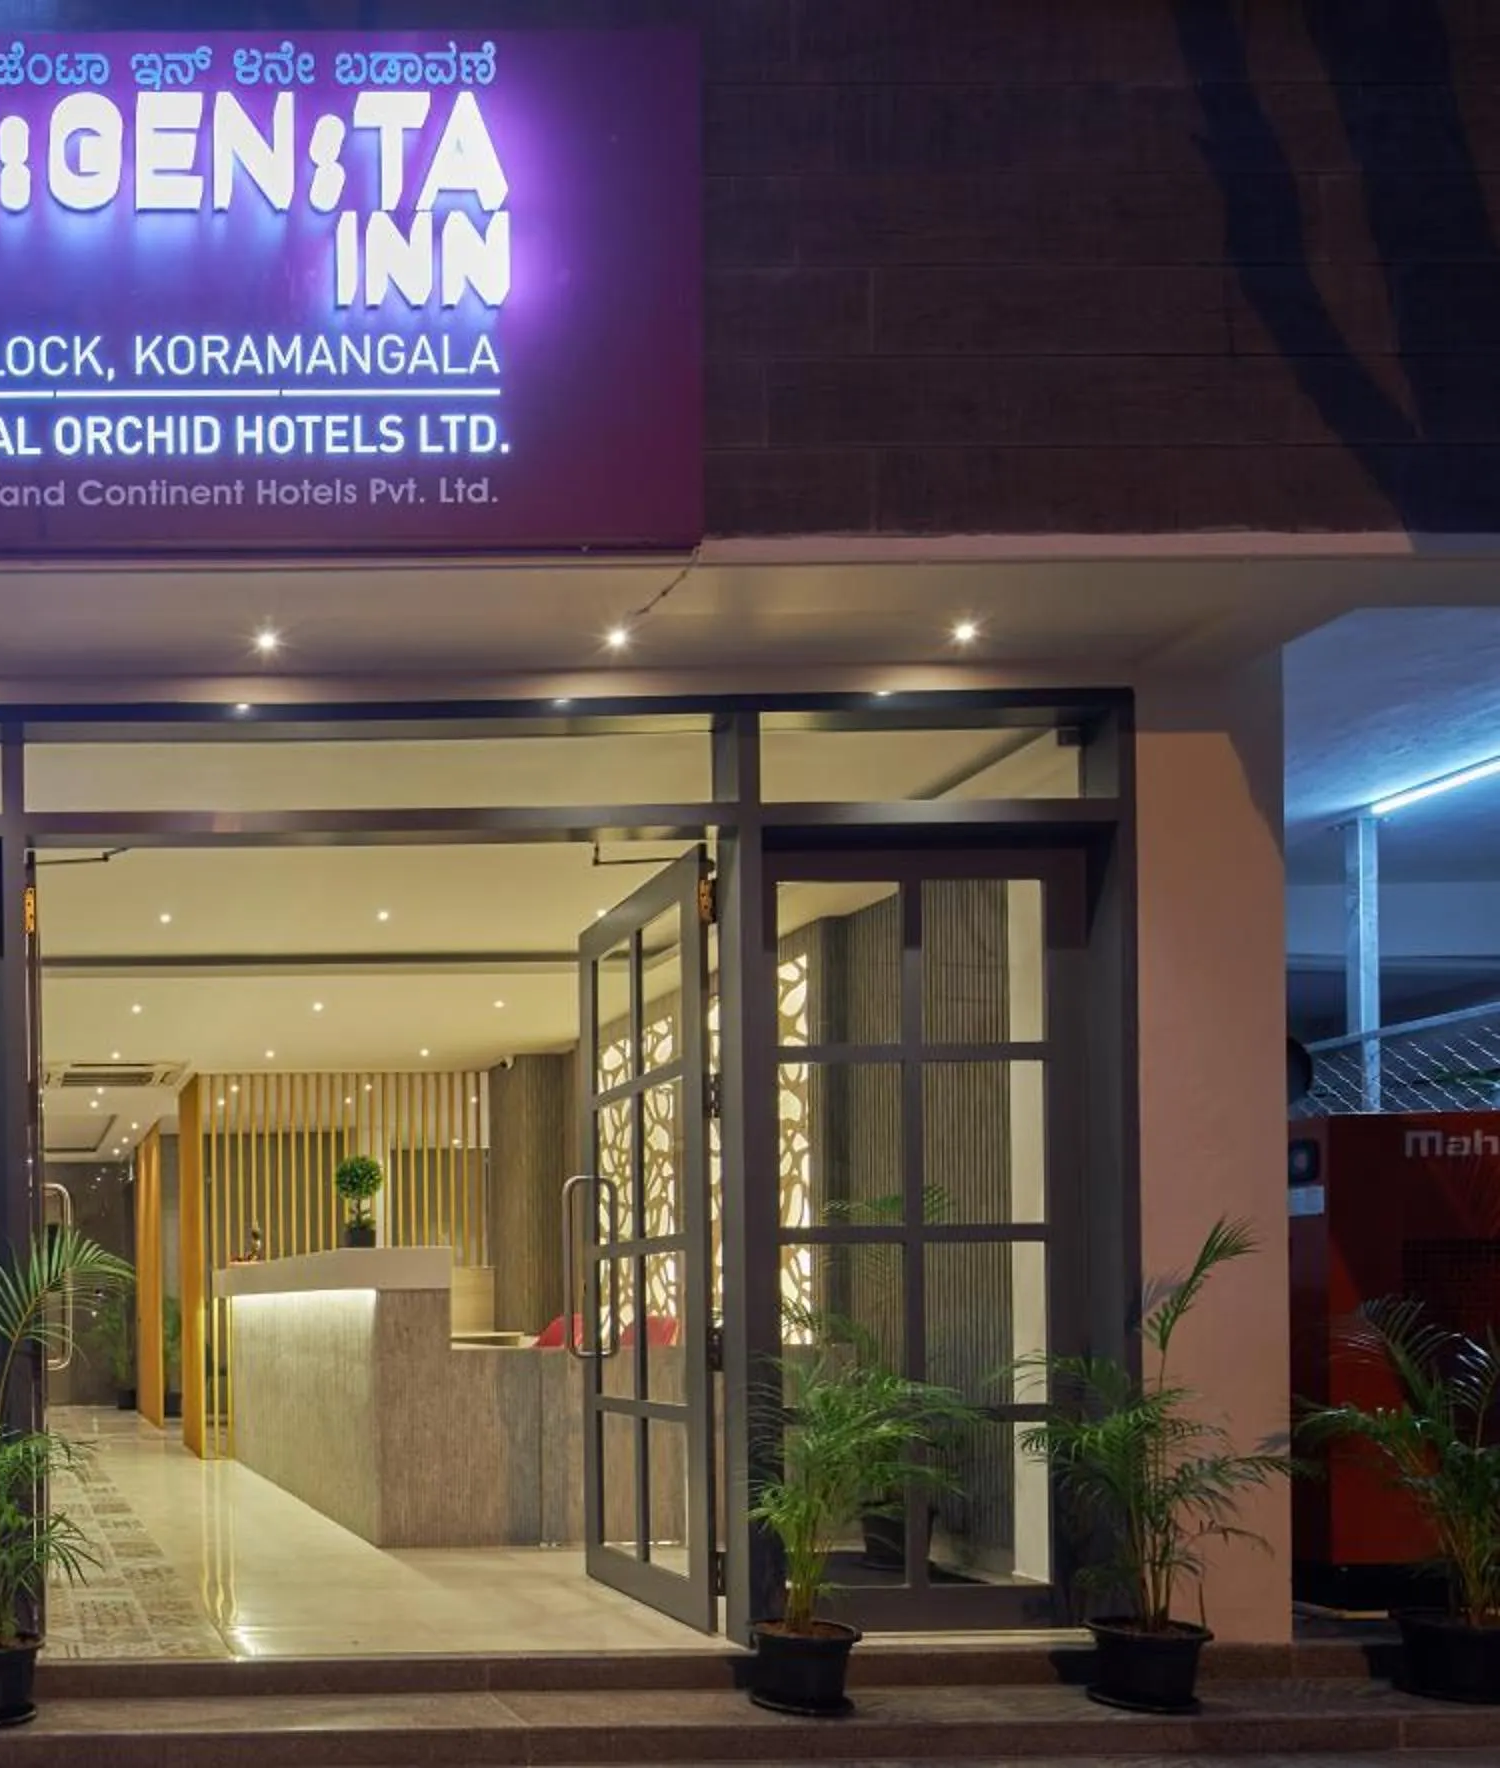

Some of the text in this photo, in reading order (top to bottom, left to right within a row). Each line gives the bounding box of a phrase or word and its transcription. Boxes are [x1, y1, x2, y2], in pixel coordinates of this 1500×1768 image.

[336, 210, 511, 309] INN
[133, 333, 501, 376] KORAMANGALA
[54, 415, 222, 457] ORCHID
[236, 414, 405, 456] HOTELS
[418, 413, 512, 455] LTD.
[77, 479, 245, 507] Continent
[256, 478, 358, 506] Hotels
[369, 478, 427, 506] Pvt.
[438, 477, 499, 505] Ltd.
